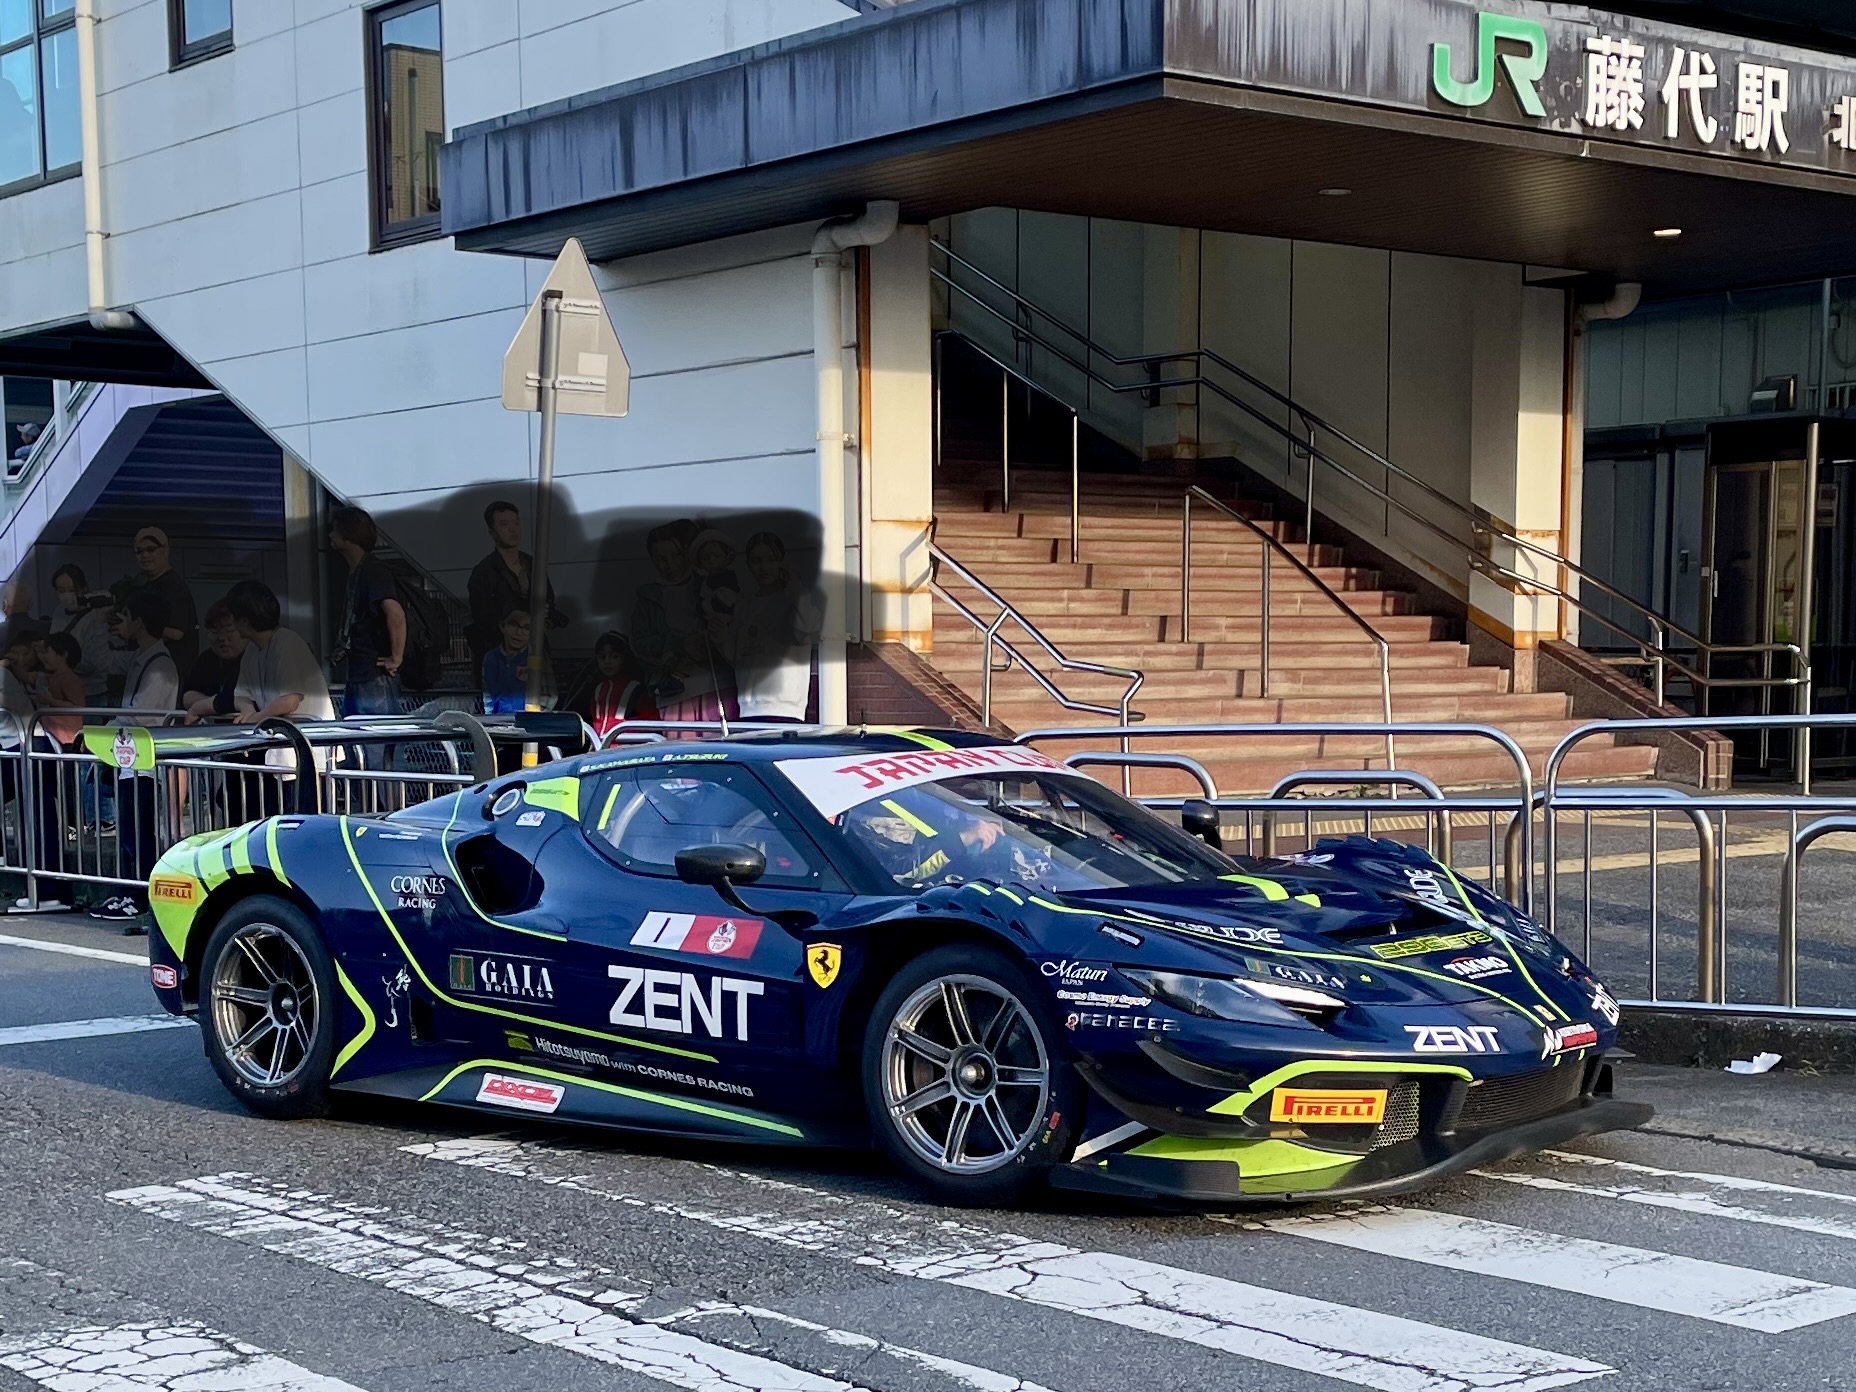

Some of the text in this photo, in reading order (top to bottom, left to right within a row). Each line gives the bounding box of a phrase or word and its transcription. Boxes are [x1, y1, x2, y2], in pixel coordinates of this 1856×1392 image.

[1431, 11, 1548, 117] JR
[1583, 35, 1790, 154] 藤代駅
[834, 749, 1001, 790] JAPAN
[155, 879, 192, 900] PIRELLI
[390, 875, 446, 895] CORNES
[398, 896, 437, 909] RACING
[480, 957, 555, 993] GAIA
[607, 964, 765, 1042] ZENT
[1403, 1024, 1503, 1053] ZENT
[535, 1036, 755, 1098] Hitotsuyama with CORNES RACING
[1283, 1095, 1377, 1117] PIRELLI
